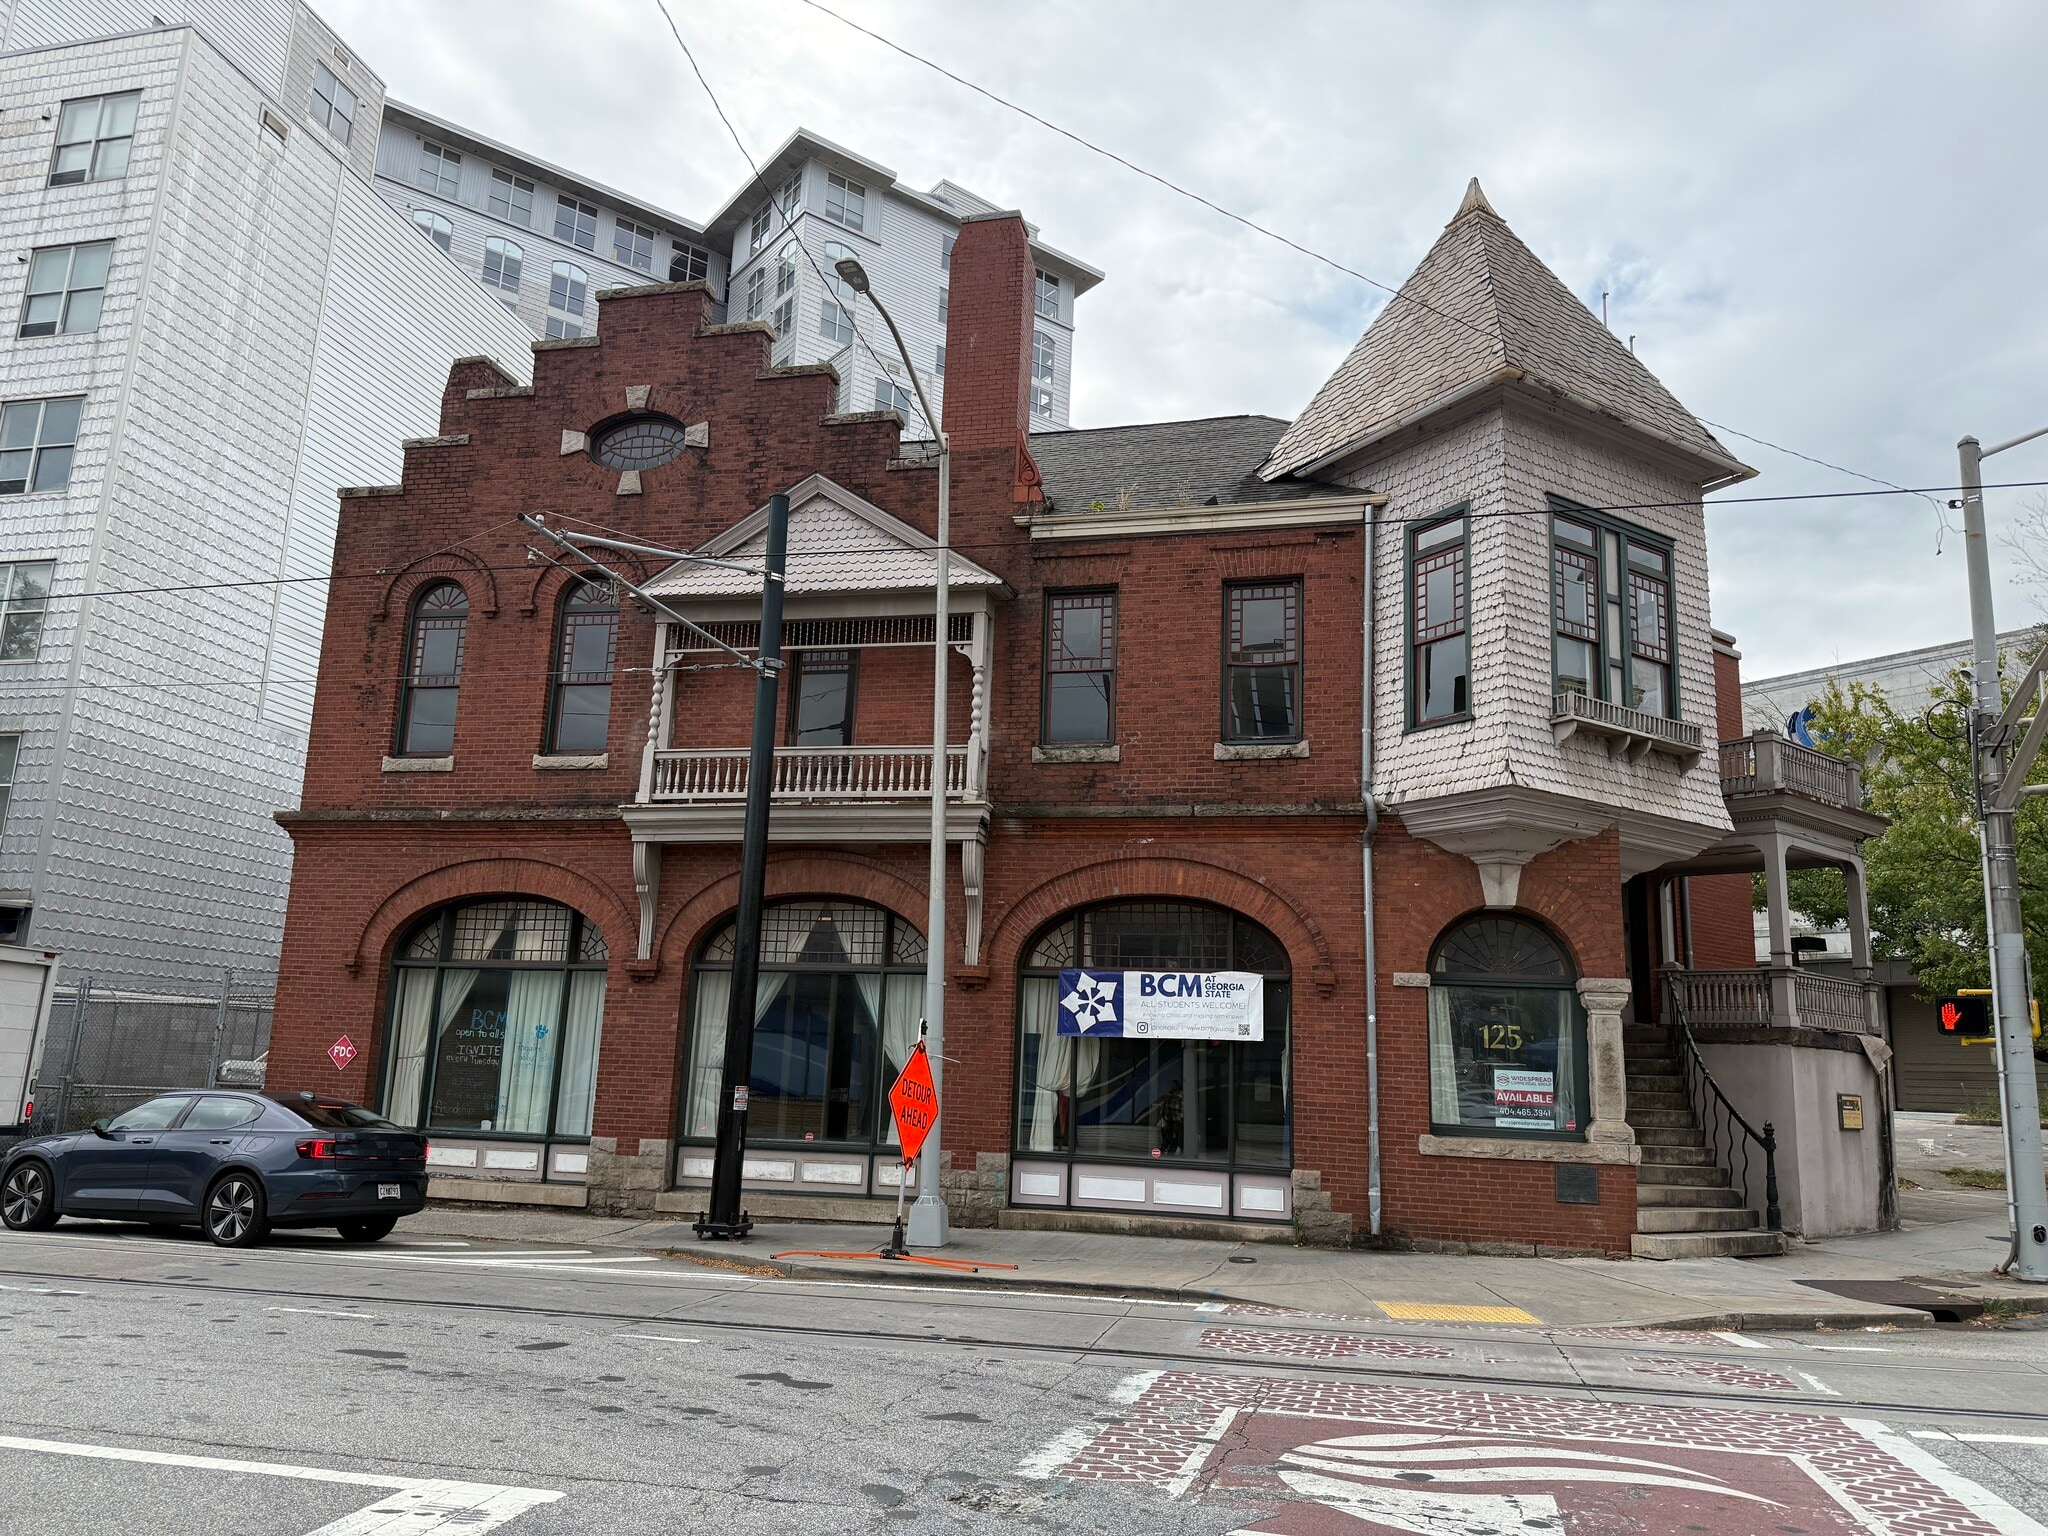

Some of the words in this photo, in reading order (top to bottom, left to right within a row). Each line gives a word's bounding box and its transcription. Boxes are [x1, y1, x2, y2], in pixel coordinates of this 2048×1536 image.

[1140, 973, 1202, 997] BCM
[1204, 975, 1216, 983] AT
[1204, 982, 1245, 991] GEORGIA
[1204, 990, 1231, 998] STATE
[1157, 1001, 1199, 1009] STUDENTS
[1201, 1001, 1246, 1010] WELCOME!
[470, 1008, 507, 1030] BCM
[455, 1029, 475, 1039] open
[478, 1028, 487, 1038] to
[1479, 1024, 1523, 1050] 125
[333, 1045, 352, 1058] FDC
[446, 1054, 468, 1064] every
[469, 1055, 500, 1066] Tuesday
[1510, 1075, 1552, 1083] WIDESPREAD
[901, 1077, 931, 1105] DETOUR
[1496, 1092, 1553, 1104] AVAILABLE
[900, 1105, 928, 1130] AHEAD
